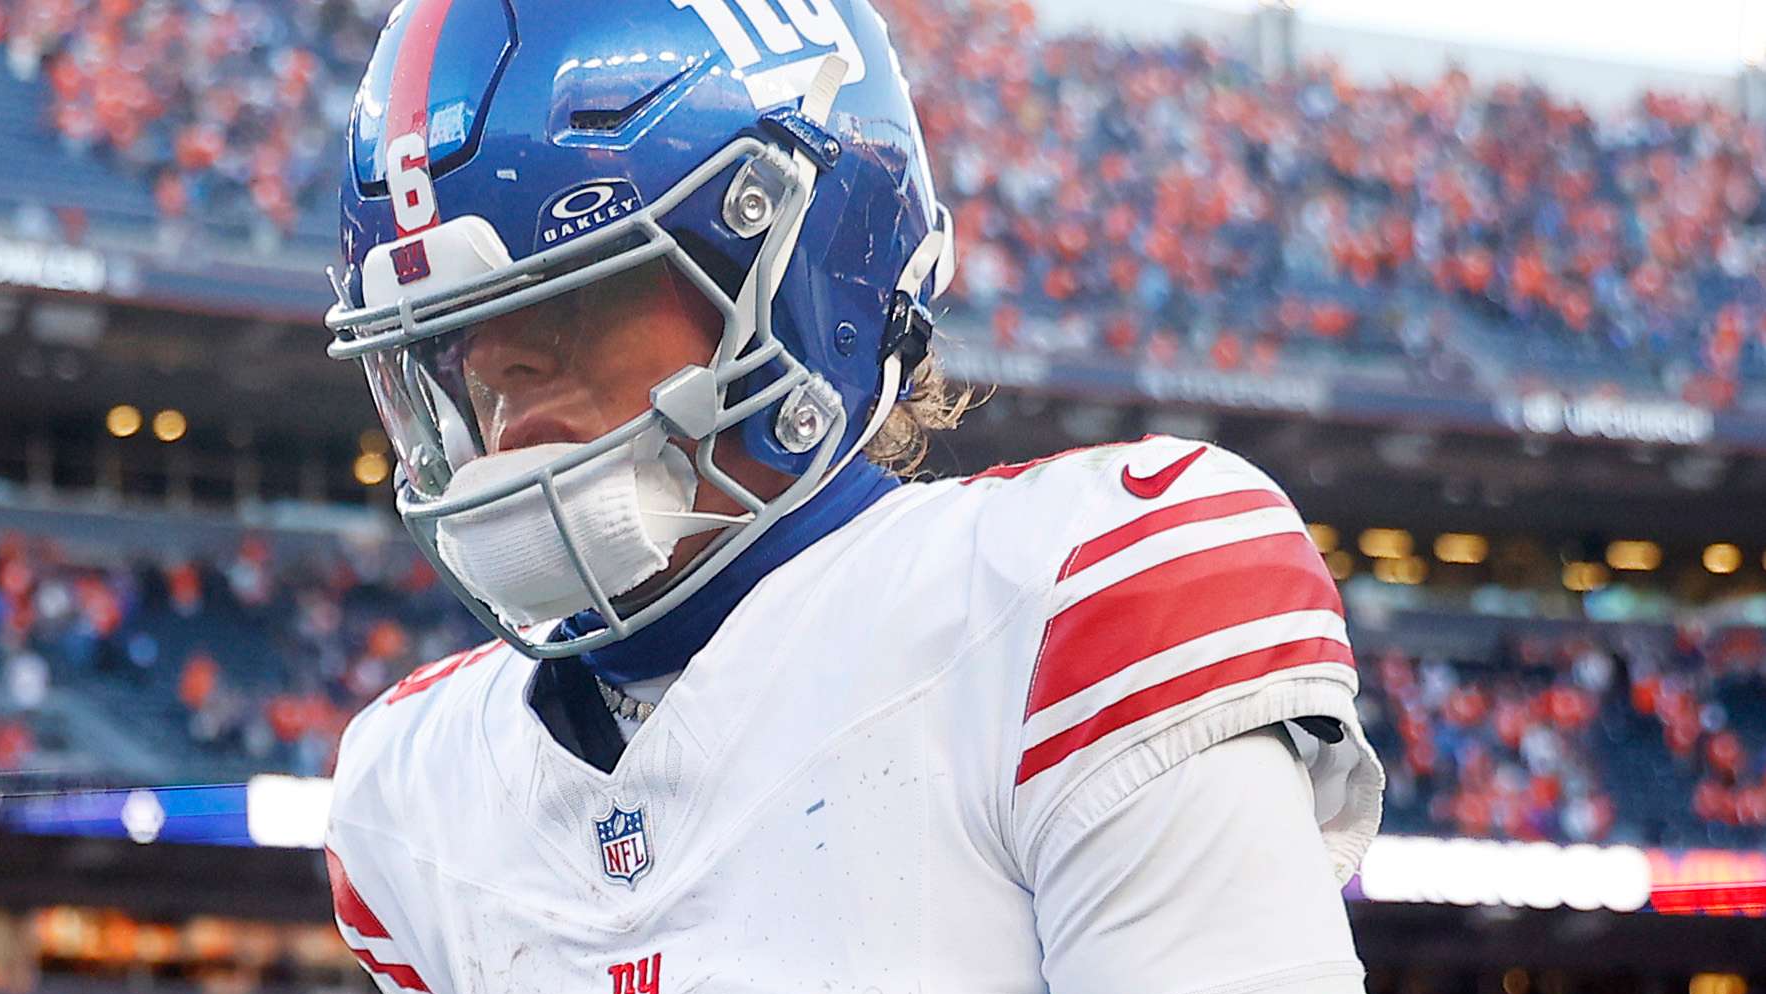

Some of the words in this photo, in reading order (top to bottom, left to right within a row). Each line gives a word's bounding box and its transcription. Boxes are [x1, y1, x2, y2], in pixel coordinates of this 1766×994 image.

[386, 132, 435, 232] 6
[543, 197, 637, 242] OAKLEY
[605, 837, 644, 873] NFL
